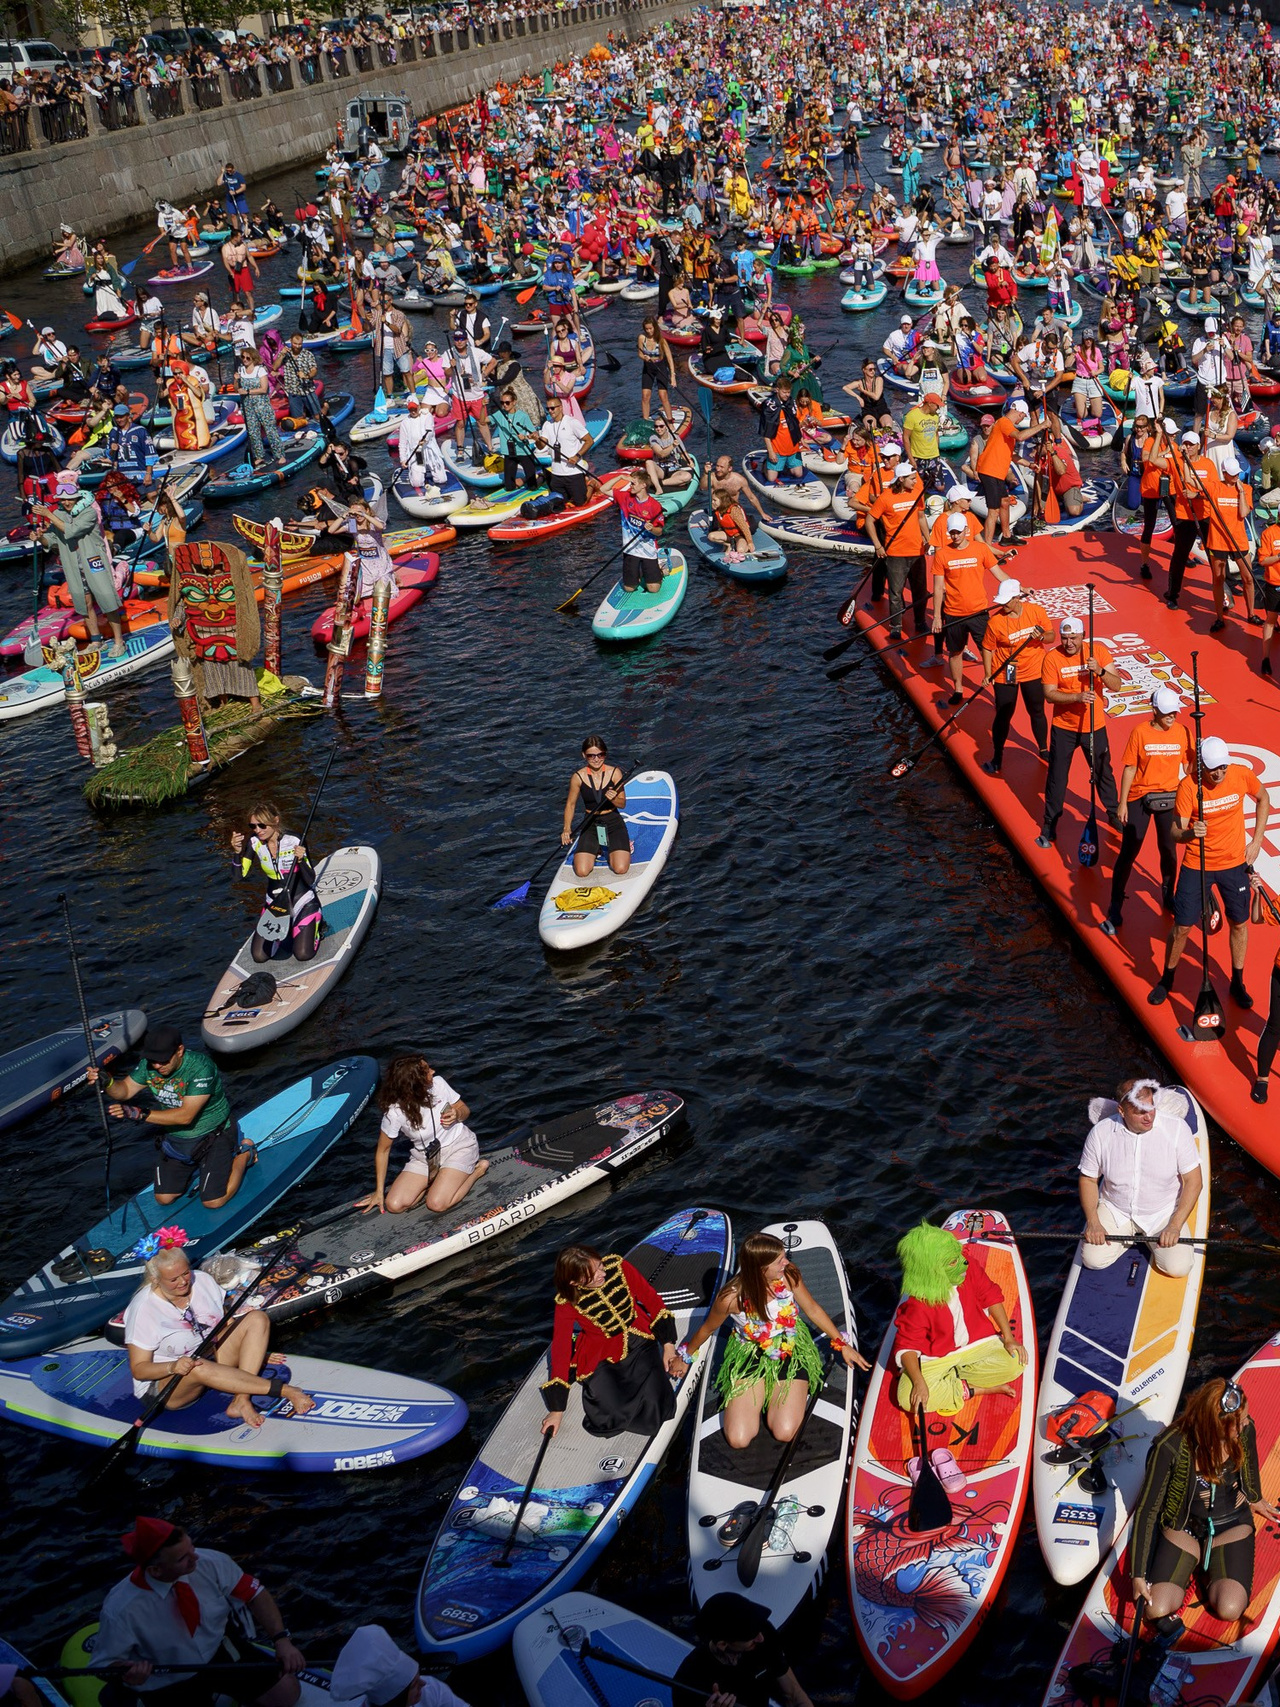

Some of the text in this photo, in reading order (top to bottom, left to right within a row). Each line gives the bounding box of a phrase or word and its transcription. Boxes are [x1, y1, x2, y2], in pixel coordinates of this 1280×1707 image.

[629, 516, 643, 527] 1419
[298, 571, 322, 585] FUSION
[62, 1072, 90, 1093] GLADIAT
[467, 1202, 537, 1244] BOARD
[6, 1315, 37, 1326] 4239
[1130, 1366, 1165, 1397] GLADIATOR
[312, 1398, 386, 1421] JOBE
[333, 1452, 379, 1472] JOBE
[1059, 1507, 1098, 1520] 6335
[440, 1605, 480, 1624] 6389
